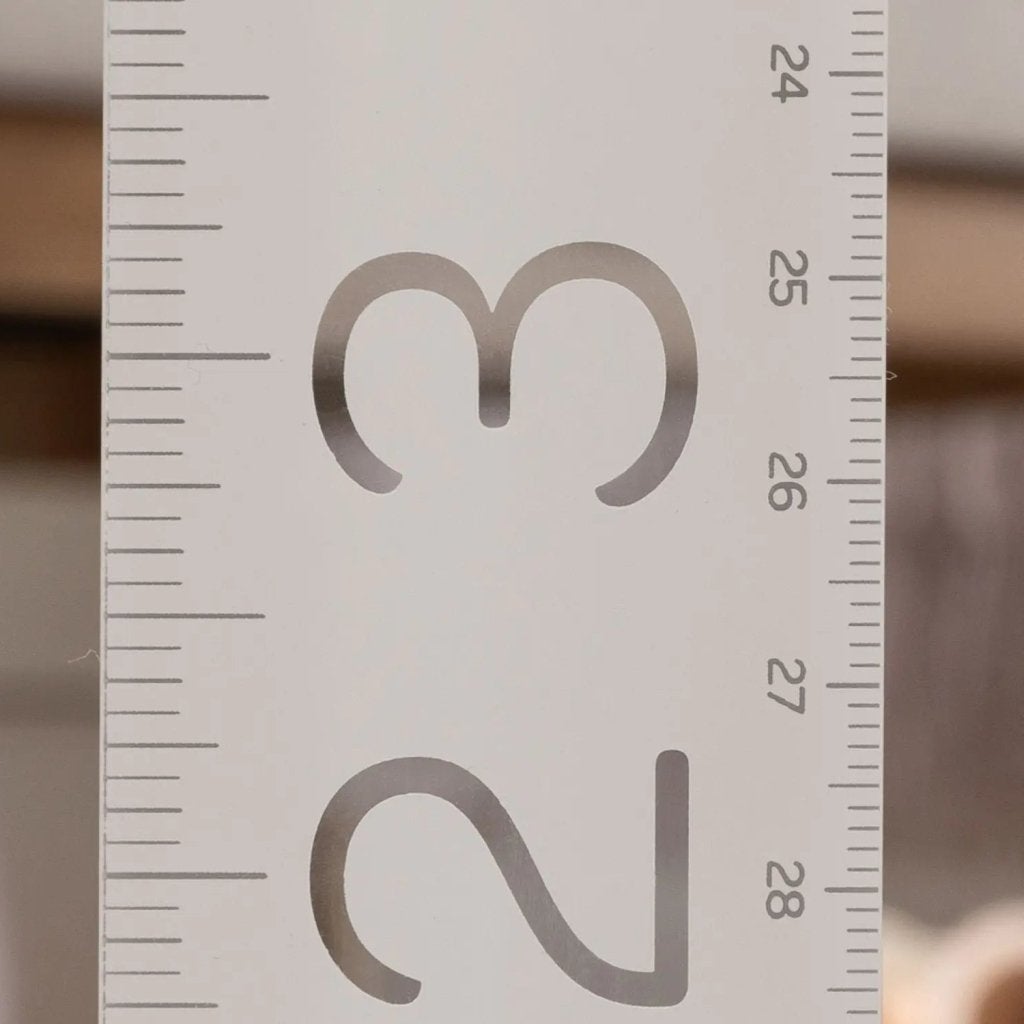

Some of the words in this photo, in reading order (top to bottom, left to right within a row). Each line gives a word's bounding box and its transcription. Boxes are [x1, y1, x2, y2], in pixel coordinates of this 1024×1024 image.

[769, 43, 810, 104] 24
[768, 249, 809, 308] 25
[312, 241, 699, 508] 3
[767, 451, 808, 512] 26
[766, 657, 807, 715] 27
[309, 749, 689, 1008] 2
[765, 860, 806, 920] 28
